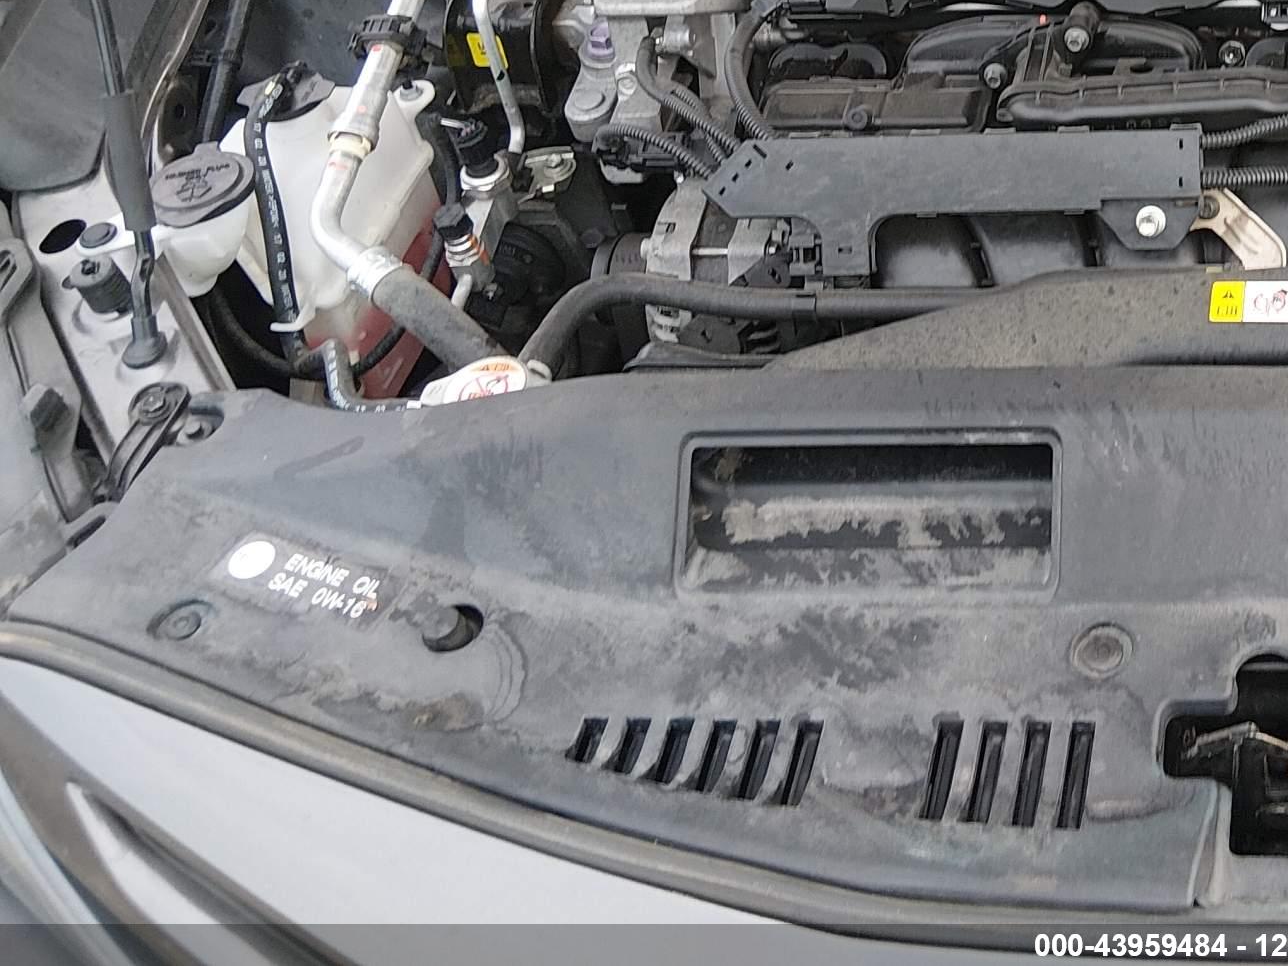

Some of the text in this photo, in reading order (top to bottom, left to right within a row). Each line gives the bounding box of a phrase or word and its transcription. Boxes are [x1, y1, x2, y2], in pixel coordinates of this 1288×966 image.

[268, 572, 367, 618] SAE 0W-16
[284, 553, 380, 600] ENGINE OIL
